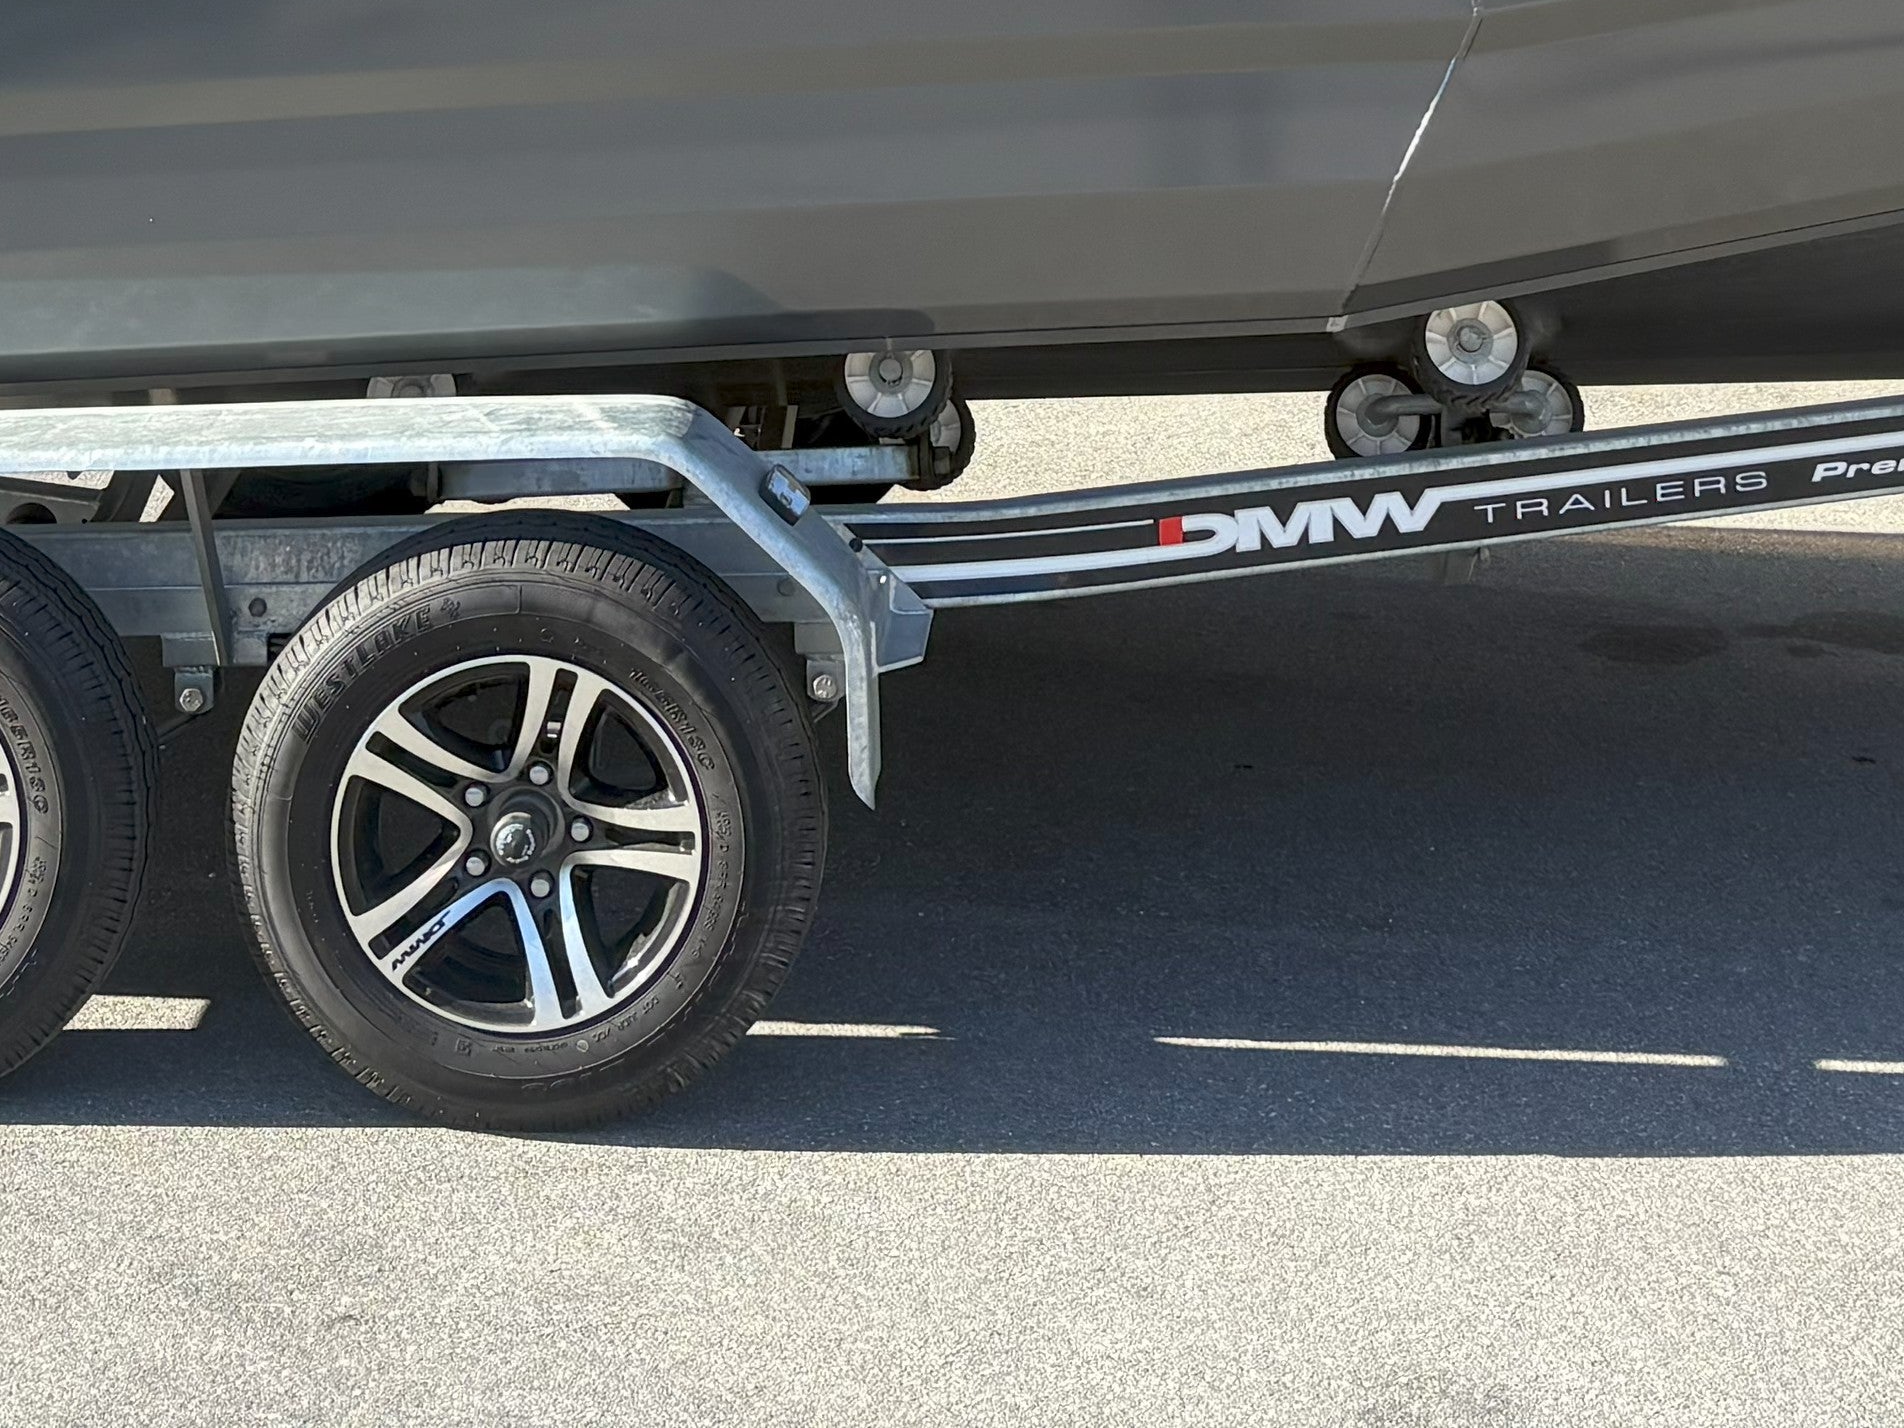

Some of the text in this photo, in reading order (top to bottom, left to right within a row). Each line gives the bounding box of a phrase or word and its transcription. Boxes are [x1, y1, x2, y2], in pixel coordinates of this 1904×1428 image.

[1158, 489, 1444, 556] DMW
[1473, 470, 1768, 524] TRAILERS
[293, 601, 434, 743] WESTLAKE
